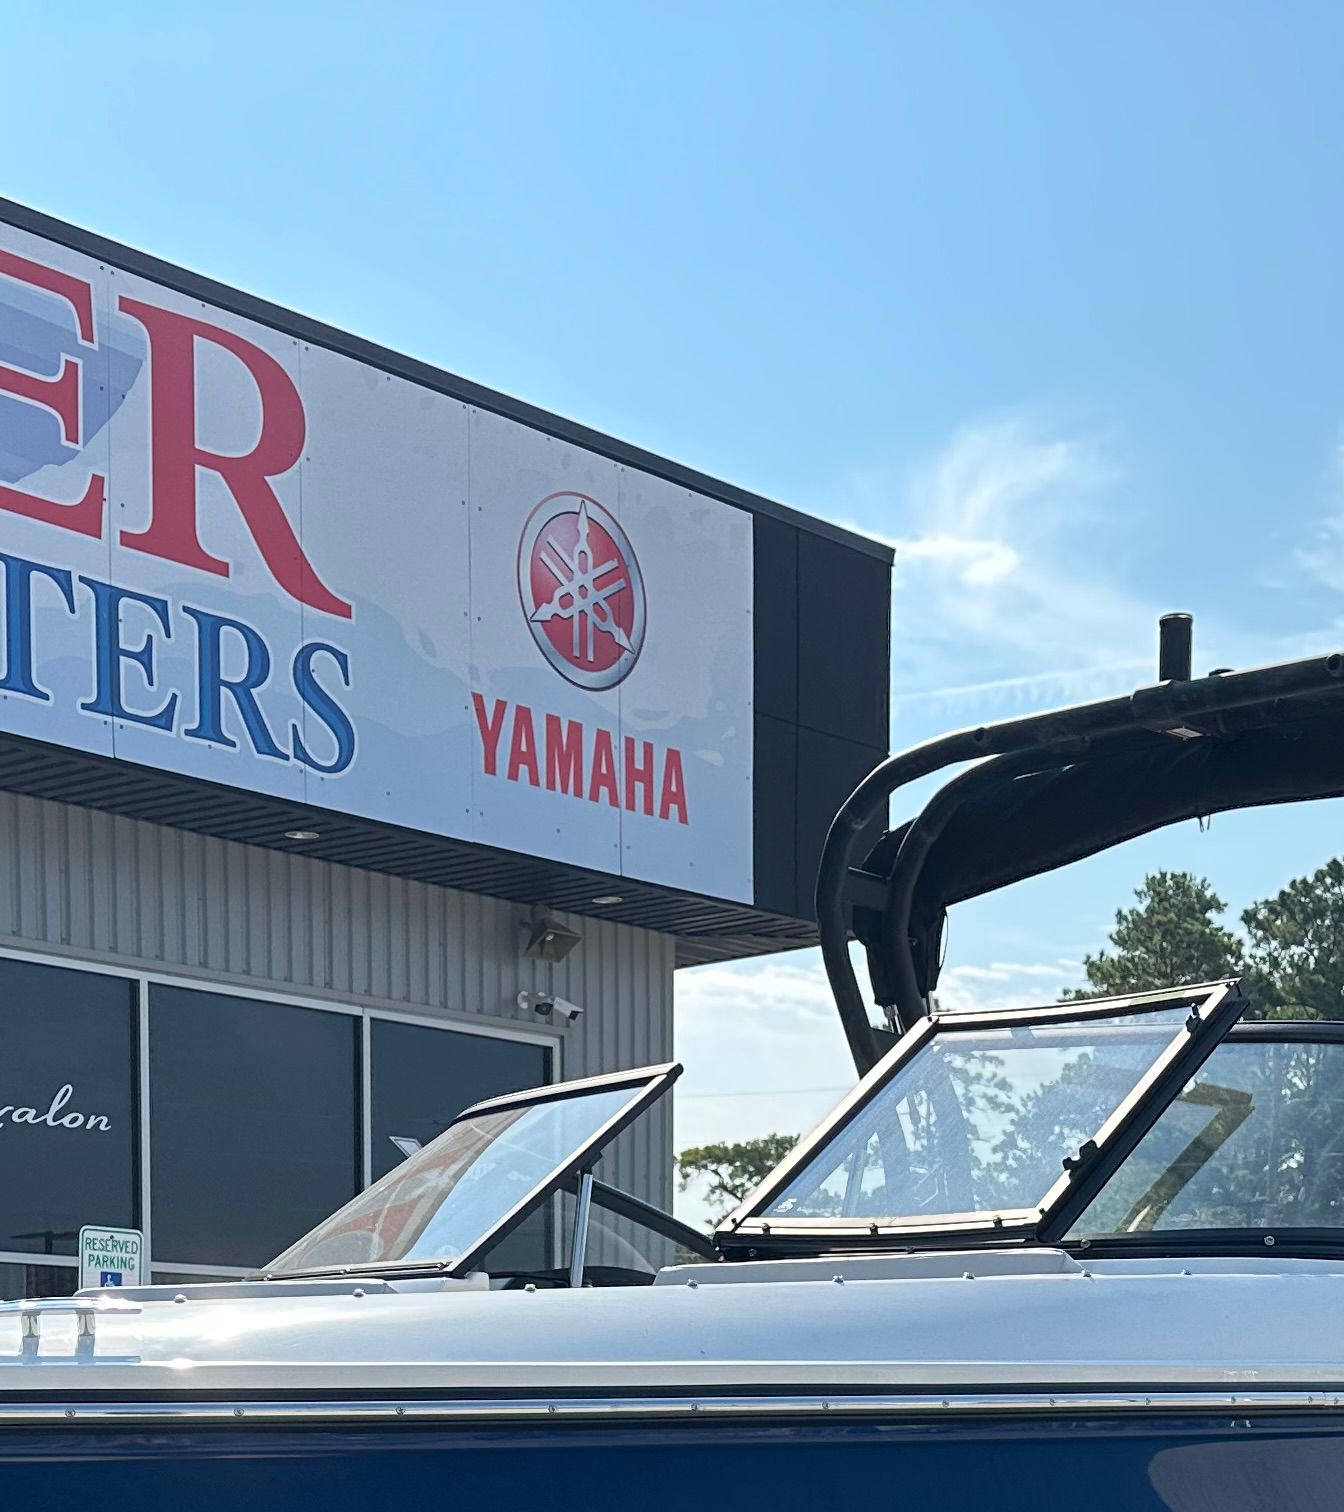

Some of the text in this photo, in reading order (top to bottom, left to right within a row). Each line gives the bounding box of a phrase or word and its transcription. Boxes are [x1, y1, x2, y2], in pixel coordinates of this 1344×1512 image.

[471, 692, 689, 825] YAMAHA
[84, 1237, 138, 1255] RESERVED
[87, 1254, 135, 1271] PARKING
